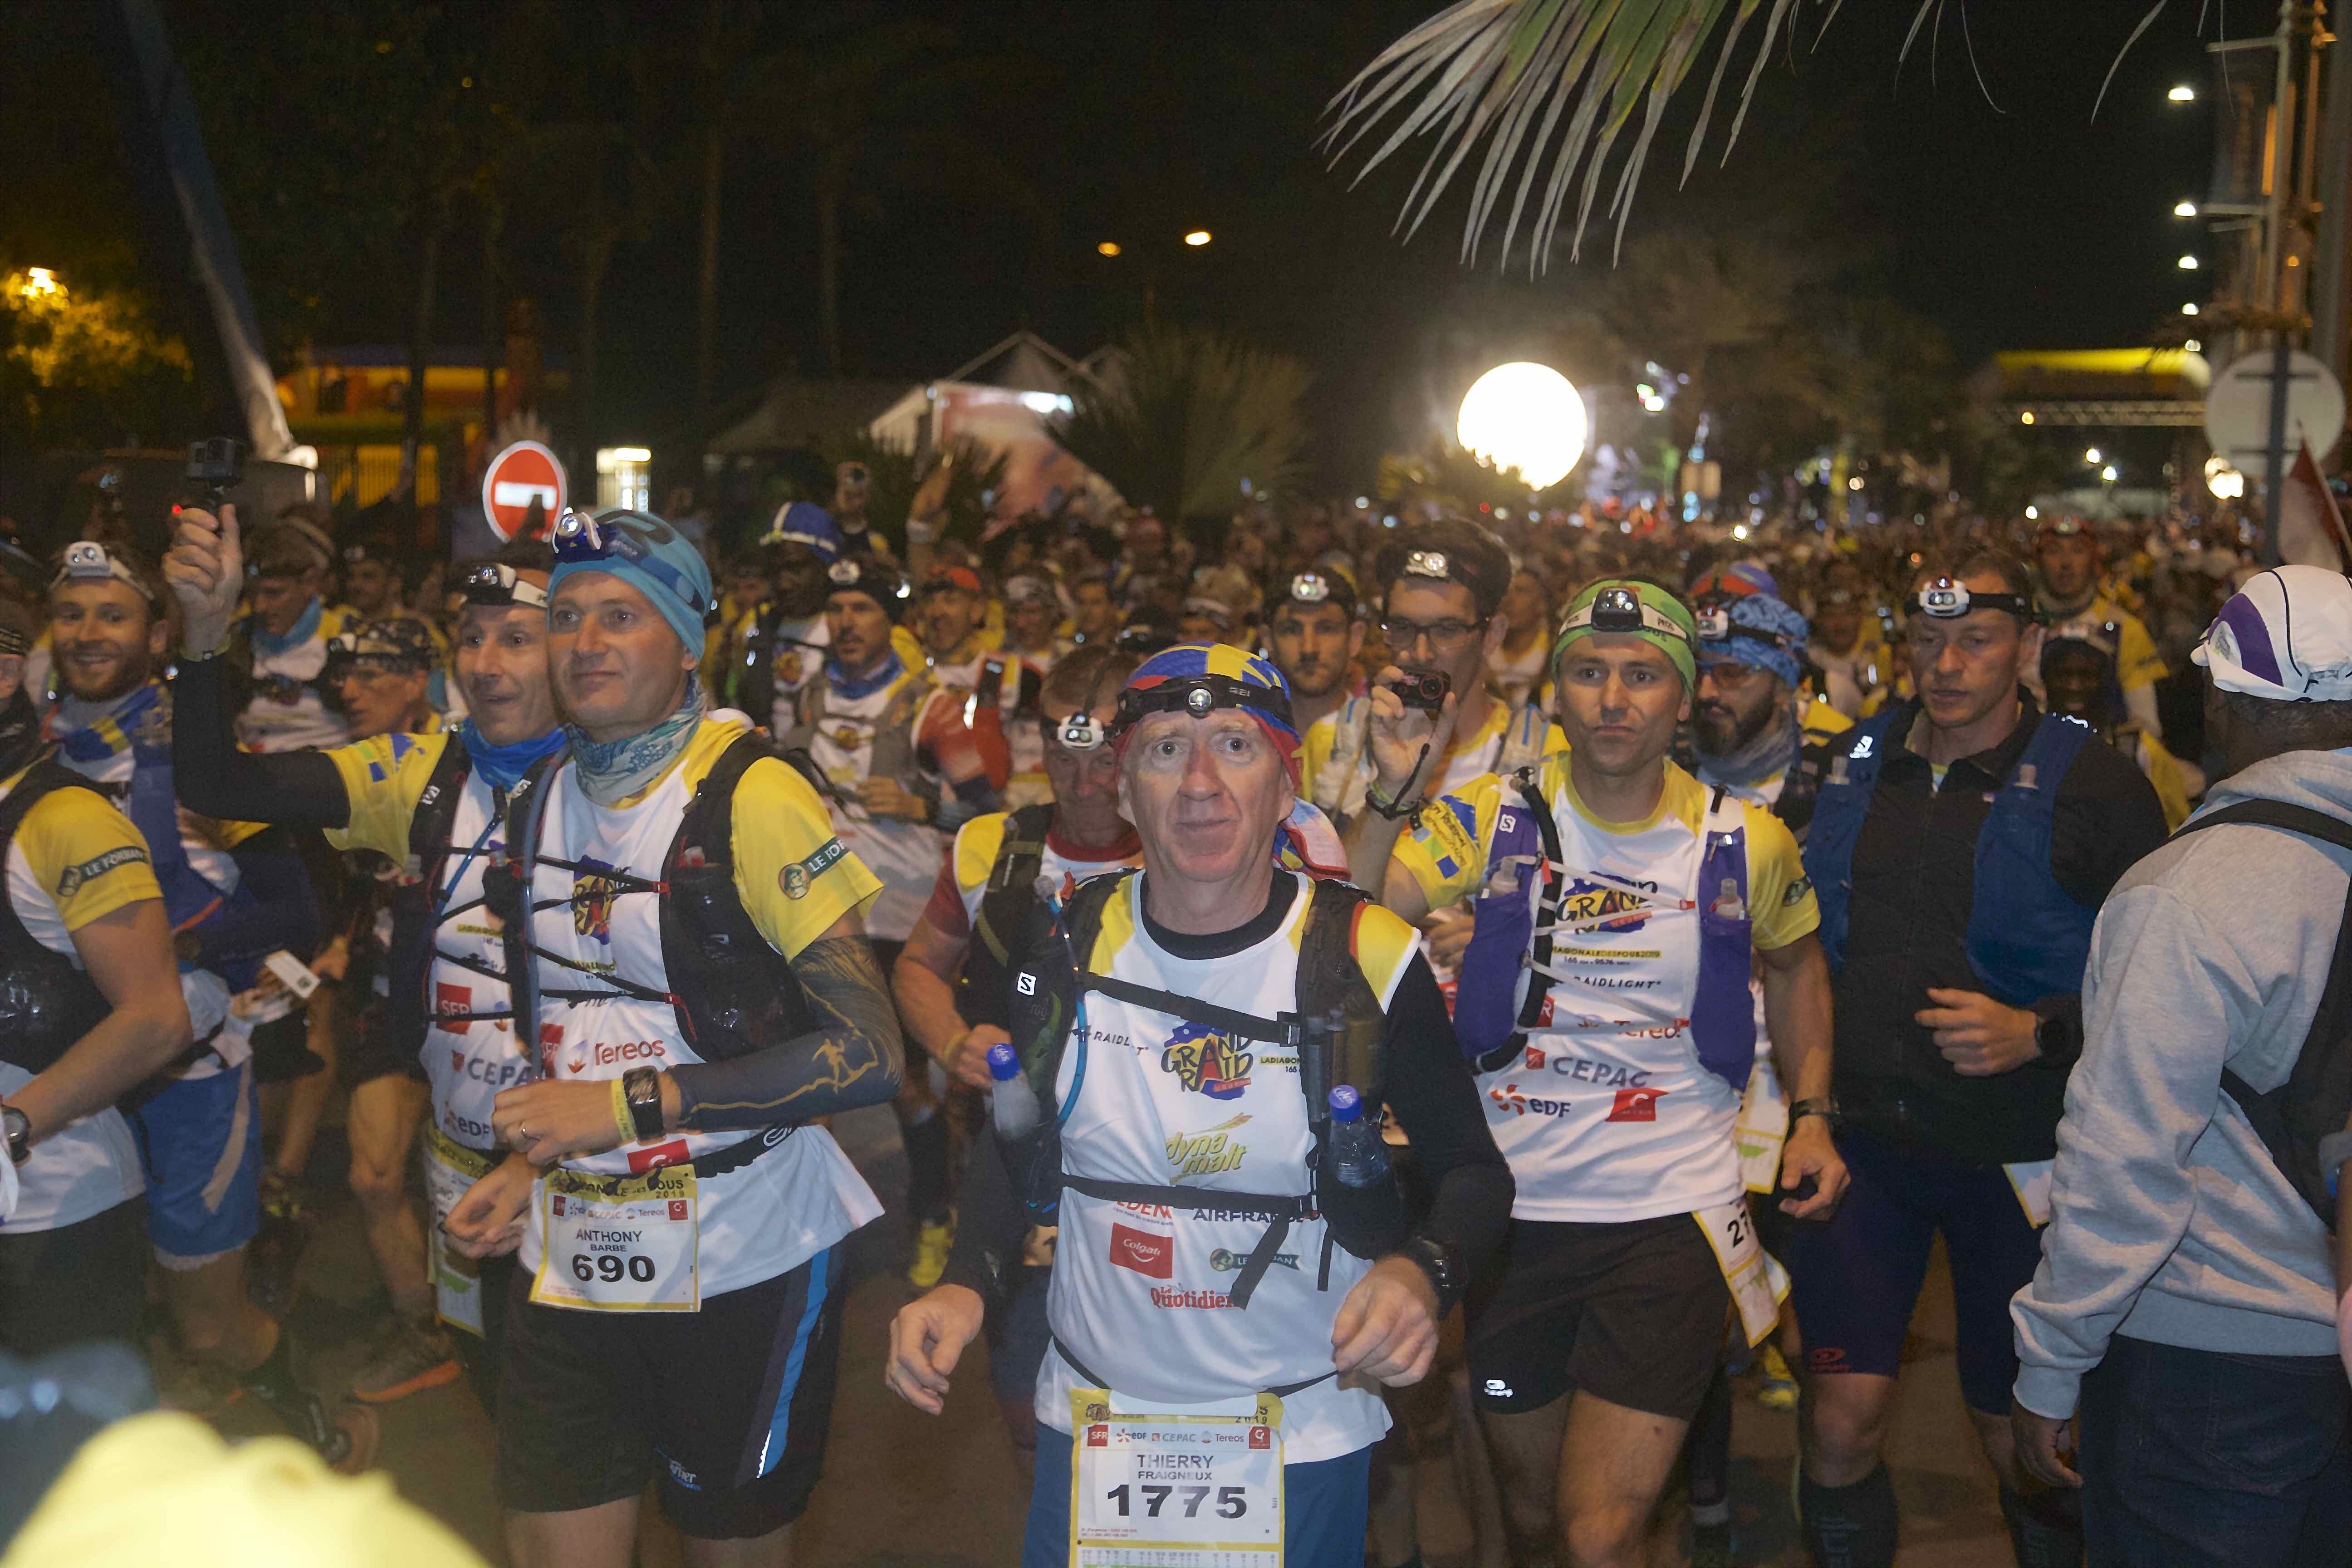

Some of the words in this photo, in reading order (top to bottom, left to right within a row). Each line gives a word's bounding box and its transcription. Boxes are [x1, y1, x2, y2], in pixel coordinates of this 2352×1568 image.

[808, 855, 827, 872] LE
[595, 1039, 666, 1066] Tereos
[468, 1058, 532, 1085] CEPA
[1553, 1057, 1652, 1087] CEPAC
[1529, 1098, 1571, 1117] eDF
[1166, 1132, 1228, 1166] dyna
[1182, 1143, 1247, 1174] malt
[653, 1180, 684, 1190] OUS
[575, 1228, 643, 1242] ANTHONY
[590, 1244, 627, 1252] BARBE
[572, 1254, 656, 1283] 690
[1092, 1431, 1108, 1440] SFR
[1162, 1433, 1196, 1442] CEPAC
[1215, 1433, 1244, 1442] Tereos
[1137, 1454, 1214, 1469] THIERRY
[1138, 1471, 1213, 1480] FRAIGNEUX
[1107, 1484, 1247, 1519] 1775
